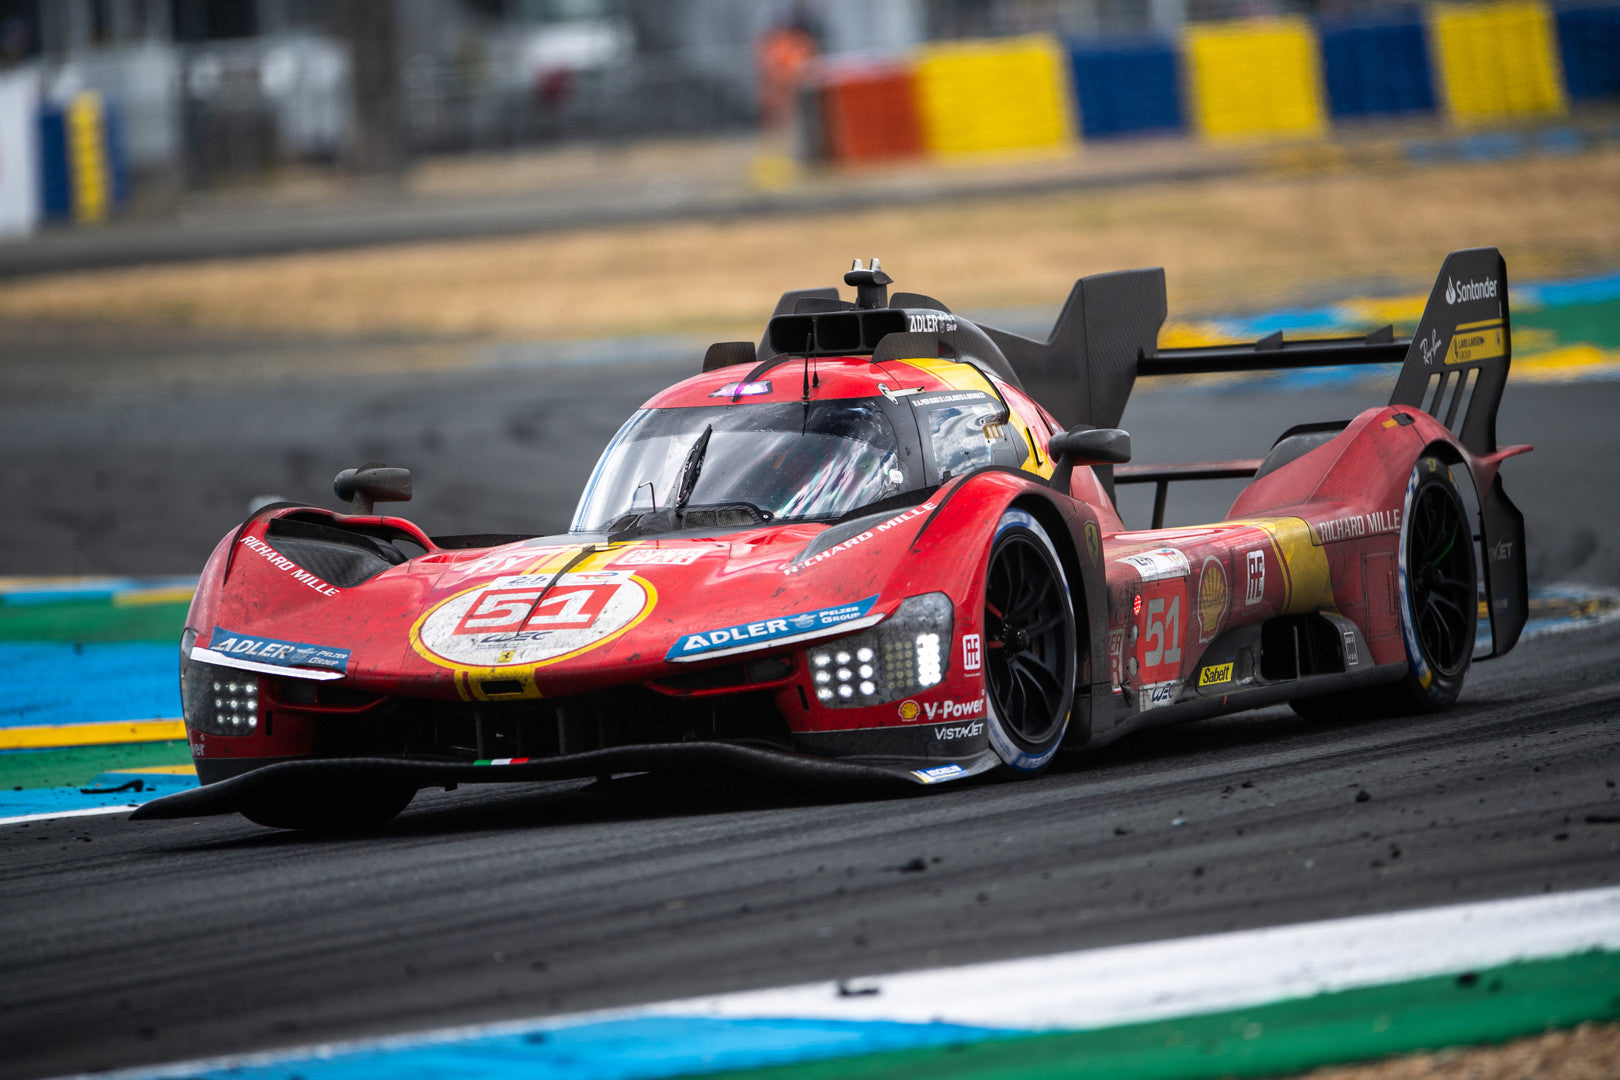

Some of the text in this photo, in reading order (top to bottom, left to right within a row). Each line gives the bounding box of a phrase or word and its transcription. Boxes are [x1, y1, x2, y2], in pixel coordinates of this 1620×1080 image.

[1456, 276, 1497, 303] Santander
[910, 314, 938, 332] ADLER
[876, 501, 938, 533] MILLE
[1319, 509, 1400, 542] RICHARD MILLE
[240, 535, 340, 598] RICHARD MILLE
[464, 589, 594, 629] 51
[683, 619, 788, 650] ADLER
[1145, 595, 1182, 667] 51
[210, 638, 296, 659] ADLER
[1203, 667, 1229, 684] Sabelt
[924, 698, 984, 720] V-Power
